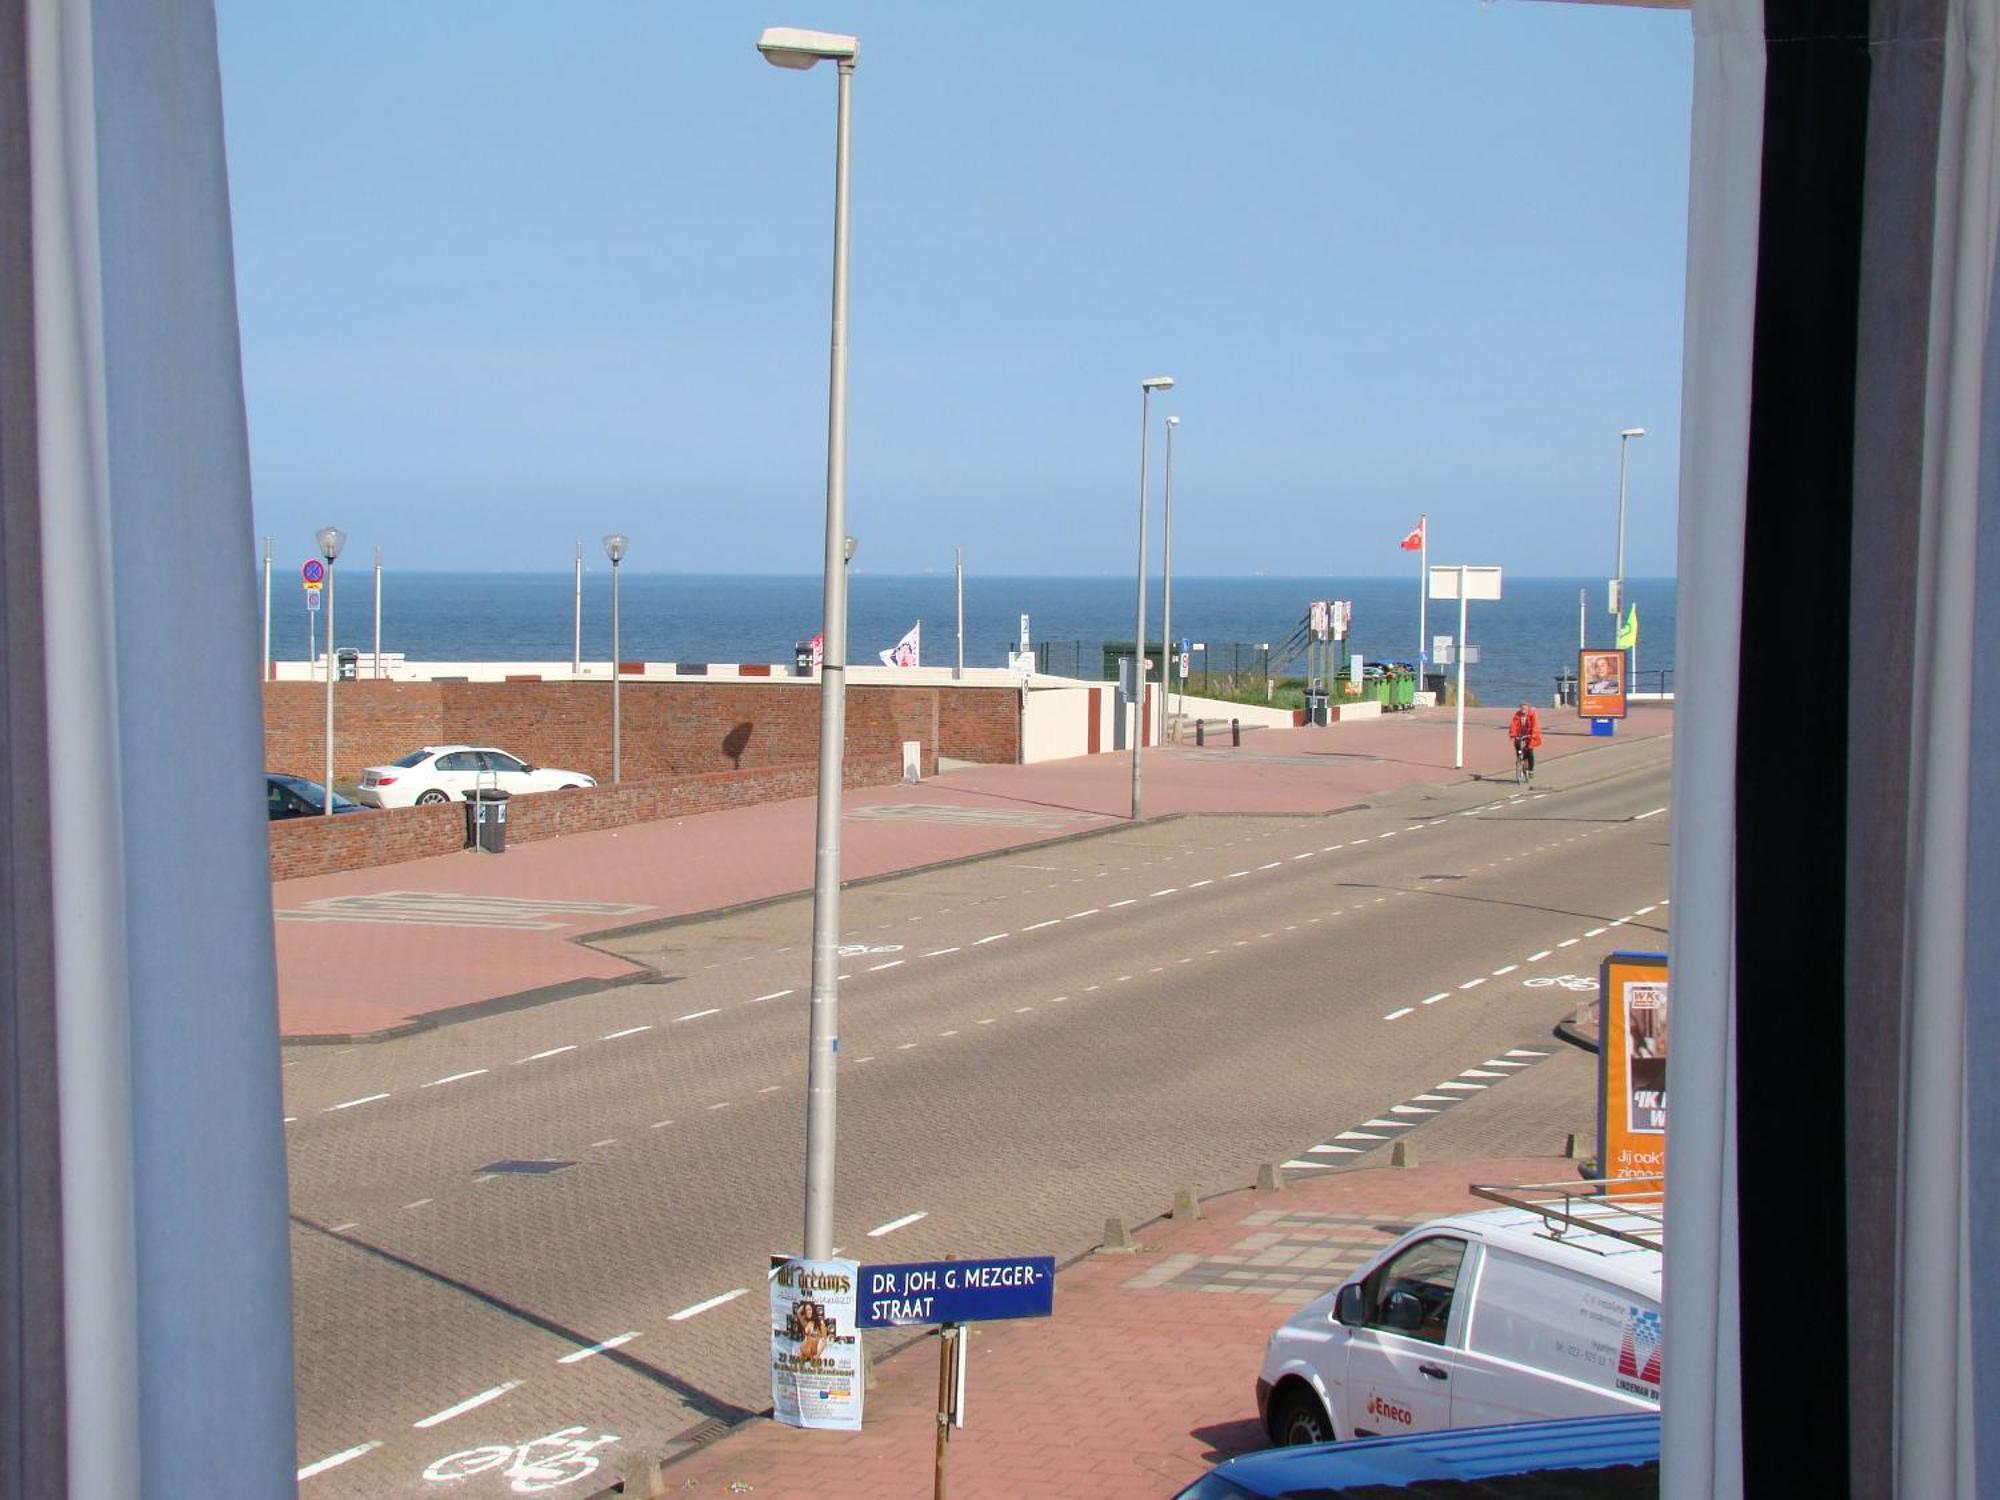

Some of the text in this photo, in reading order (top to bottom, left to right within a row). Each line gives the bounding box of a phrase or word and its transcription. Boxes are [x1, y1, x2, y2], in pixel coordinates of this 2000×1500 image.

[872, 1266, 1043, 1297] DR. JOH. G. MEZGER-
[871, 1297, 934, 1320] STRAAT
[1376, 1397, 1412, 1425] Eneco
